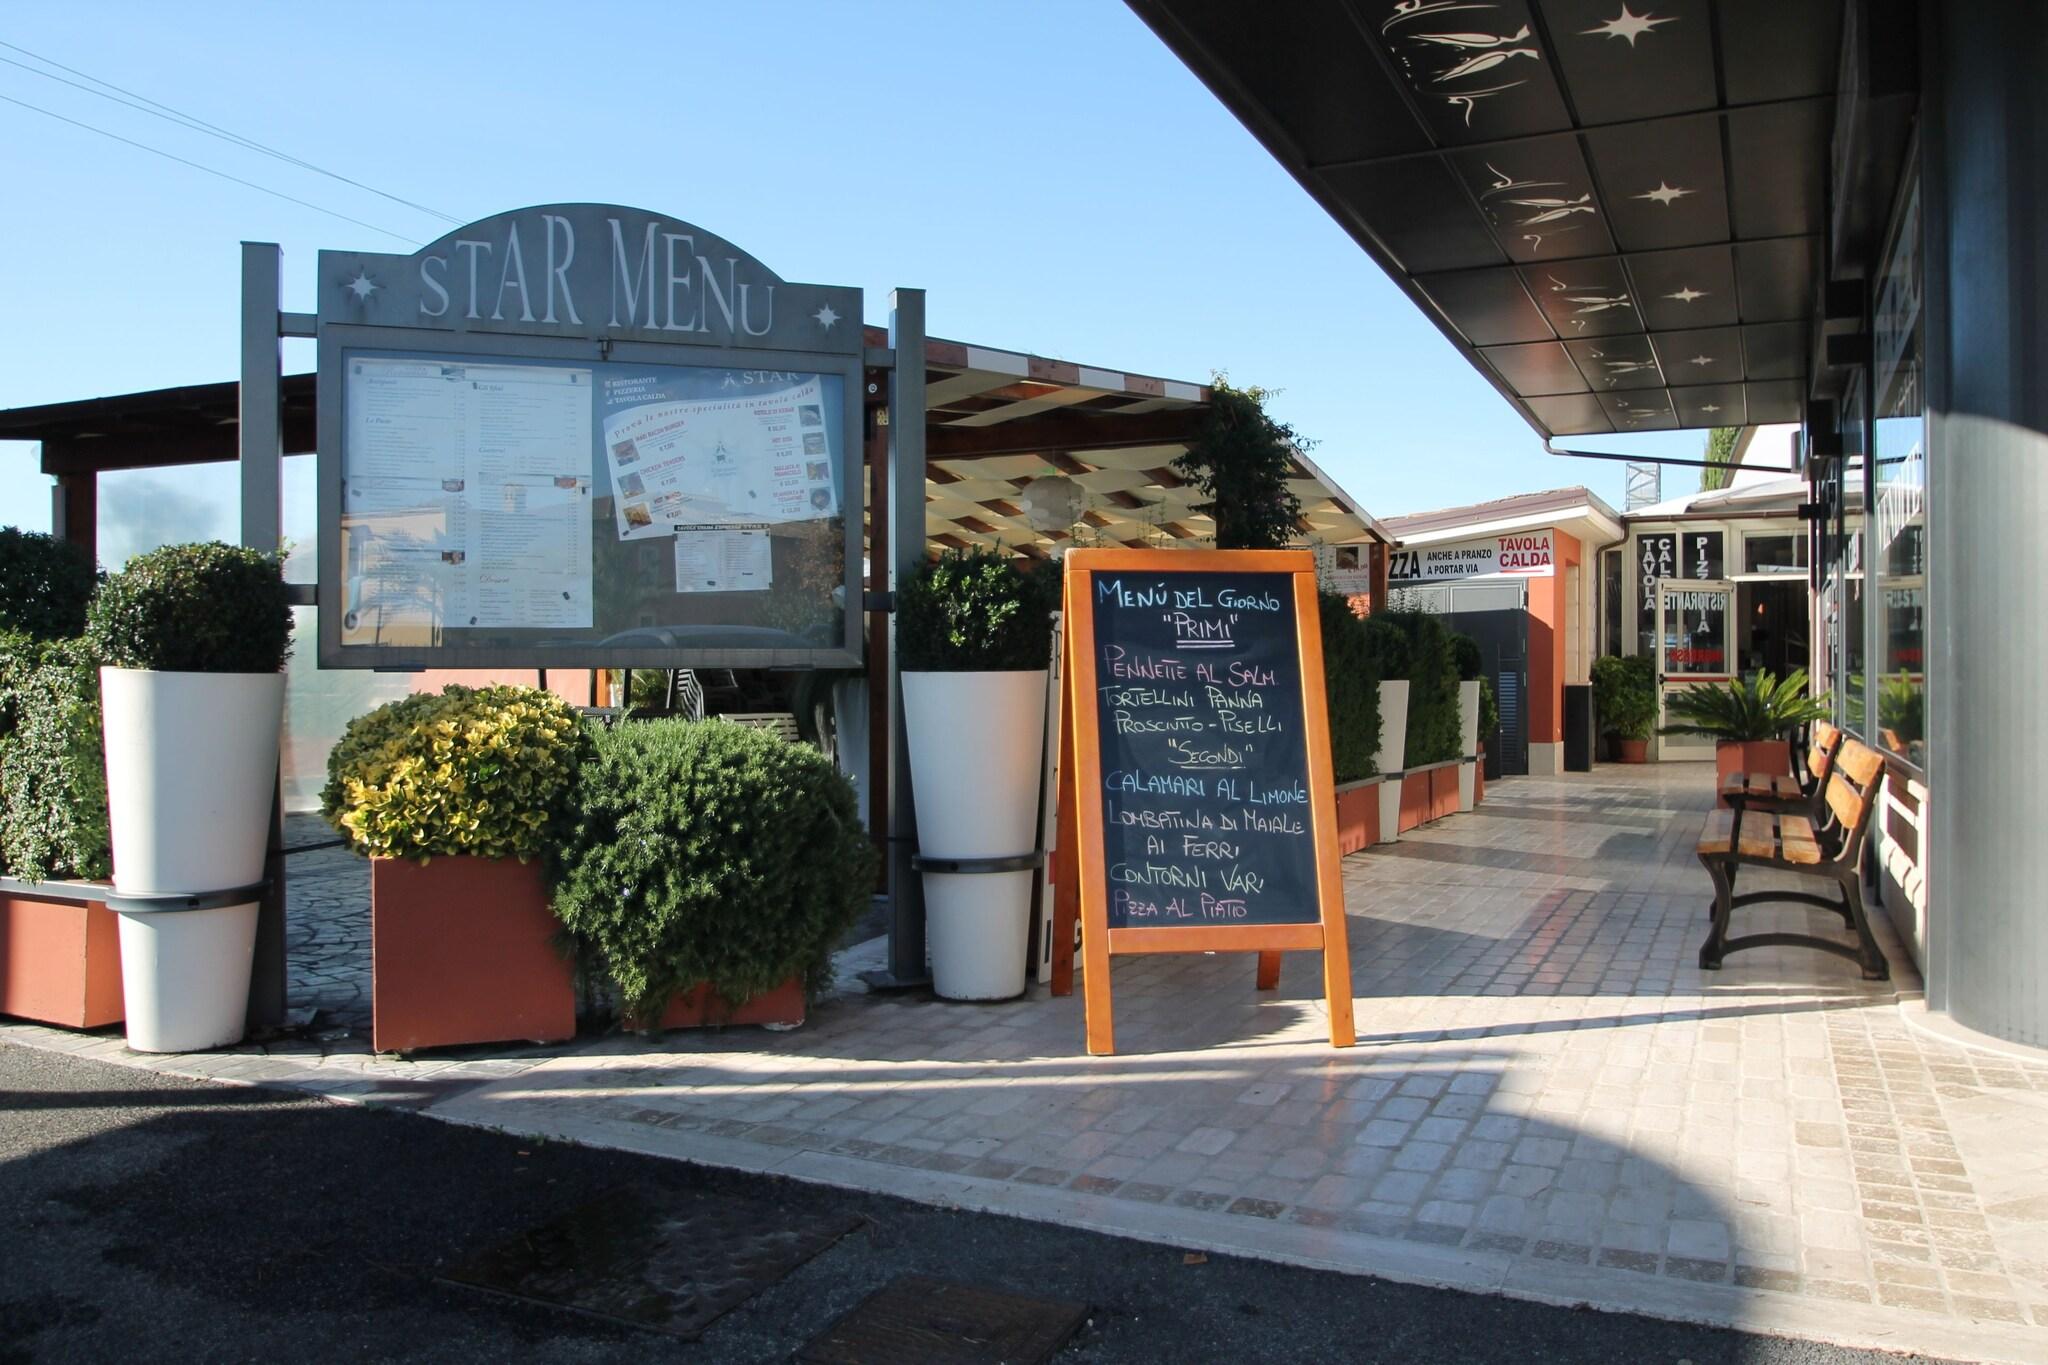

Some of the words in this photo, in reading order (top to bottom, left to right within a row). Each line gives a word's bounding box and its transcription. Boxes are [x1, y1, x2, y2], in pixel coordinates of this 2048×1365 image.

[419, 214, 583, 325] STAR
[607, 218, 775, 336] MENU
[743, 370, 799, 385] STAR
[615, 394, 642, 403] TAVOLA
[1427, 551, 1453, 561] ANCHE
[1454, 551, 1460, 560] A
[1461, 549, 1492, 559] PRANZO
[1498, 537, 1550, 551] TAVOLA
[1427, 566, 1433, 575] A
[1434, 565, 1464, 575] PORTAR
[1467, 564, 1479, 574] VIA
[1499, 552, 1551, 567] CALDA
[1642, 539, 1656, 610] TAVOLA
[1174, 586, 1214, 609] DEL
[1218, 588, 1281, 612] GIORNO
[1103, 645, 1188, 681] PENNETTE
[1196, 663, 1223, 685] AL
[1098, 685, 1195, 708] TORTELLINI
[1204, 685, 1263, 710] PANNA
[1114, 709, 1203, 735] PROSCIUTTO
[1218, 709, 1283, 734] PISELLI
[1105, 769, 1206, 797] CALAMARI
[1217, 778, 1241, 802] AL
[1250, 780, 1309, 805] LIMONE
[1108, 800, 1214, 831] LOMBATINA
[1220, 816, 1239, 831] DI
[1243, 808, 1305, 835] MAIALE
[1146, 835, 1165, 856] AI
[1182, 834, 1240, 860] FERRI
[1110, 861, 1208, 889] CONTORNI
[1220, 864, 1264, 894] VARI
[1165, 897, 1194, 919] AL
[1200, 892, 1248, 920] PIATTO
